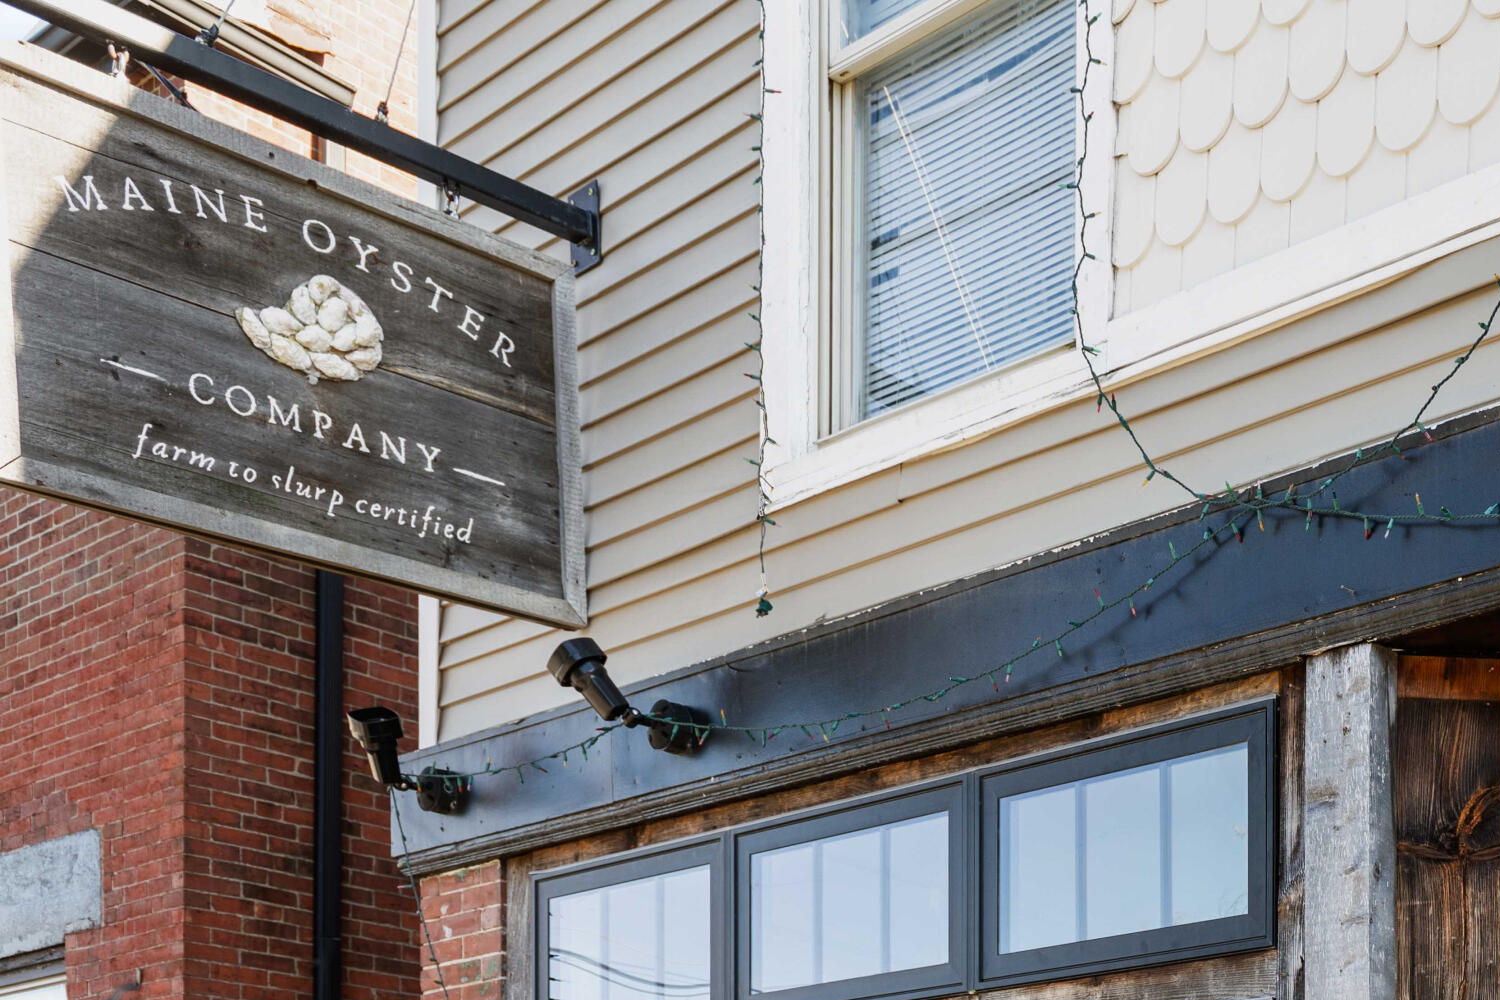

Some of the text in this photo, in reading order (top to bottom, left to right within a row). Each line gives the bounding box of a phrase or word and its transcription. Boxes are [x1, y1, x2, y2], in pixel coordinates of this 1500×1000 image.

[55, 174, 516, 367] MAINE OYSTER
[188, 372, 442, 473] COMPANY
[132, 425, 473, 544] farm to slurp certified
